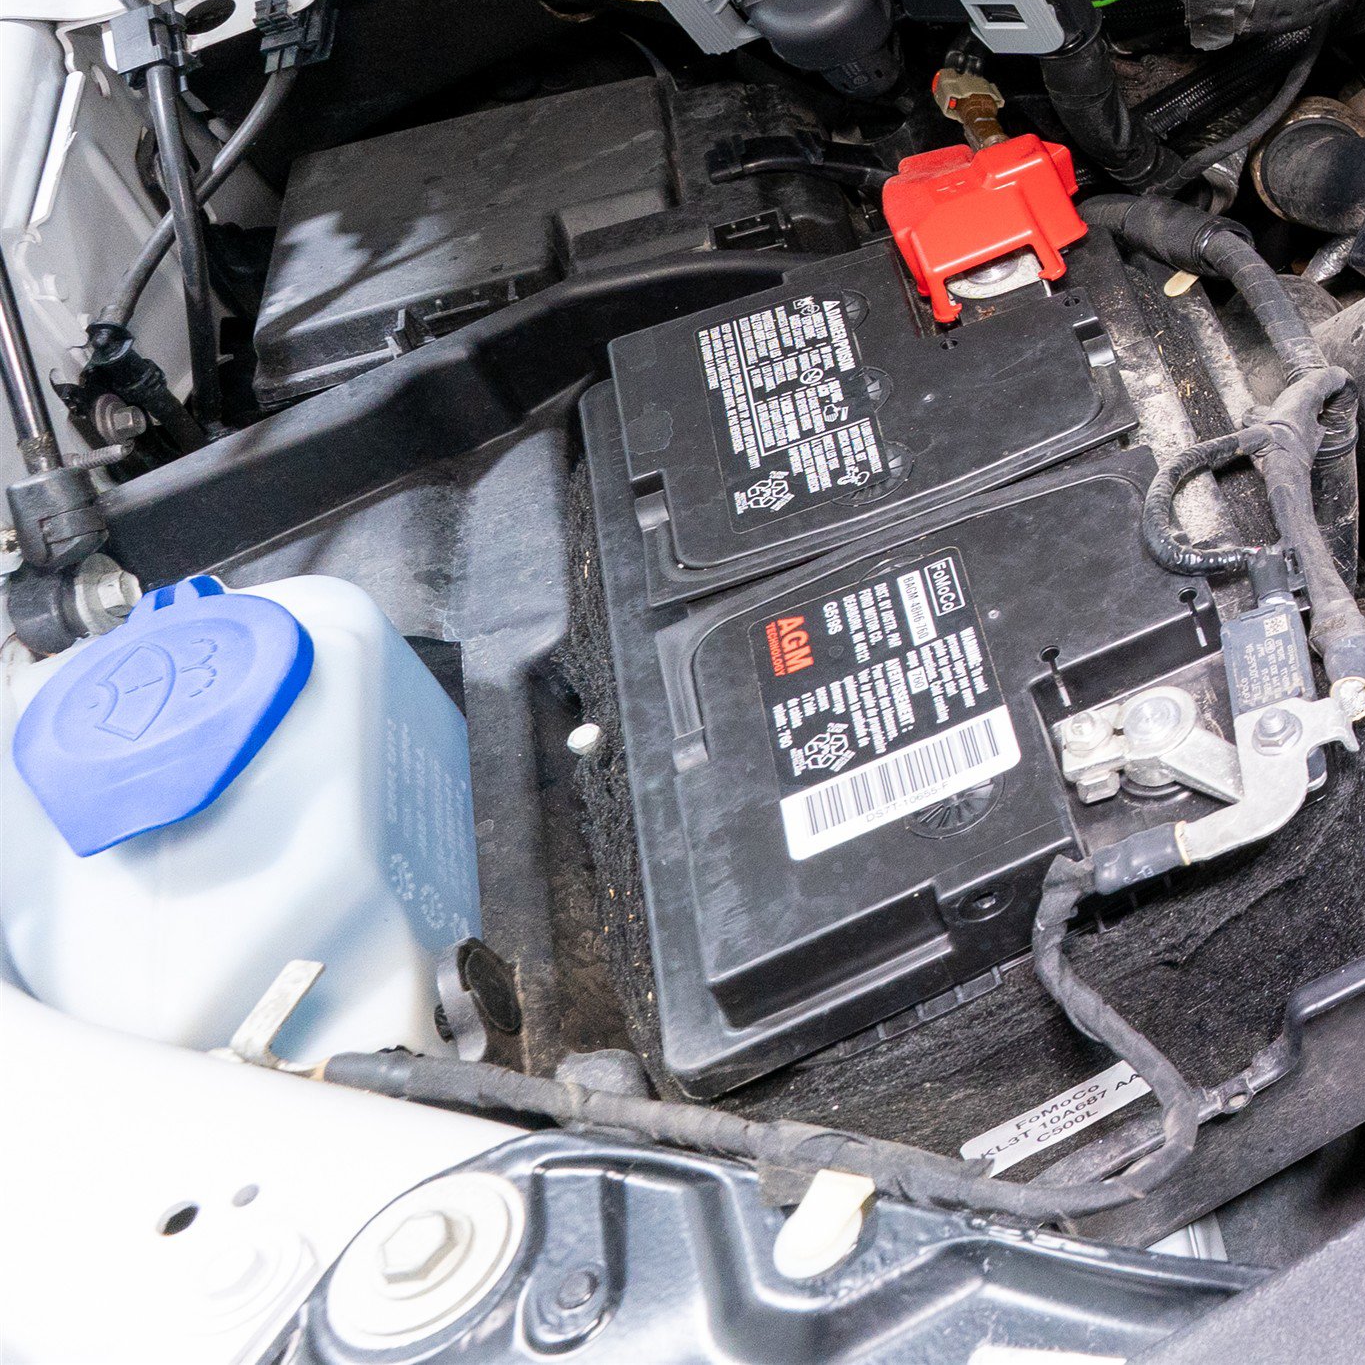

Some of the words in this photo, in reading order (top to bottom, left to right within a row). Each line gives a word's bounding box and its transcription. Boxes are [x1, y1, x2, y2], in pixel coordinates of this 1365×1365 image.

[824, 307, 854, 372] DANGER/POISON
[857, 587, 875, 608] FORD
[873, 581, 890, 601] DIST.
[928, 561, 959, 611] FoMoCo
[821, 600, 844, 635] G519S
[841, 593, 864, 634] DEARBORN,
[862, 606, 881, 633] MOTOR
[878, 598, 892, 611] BY
[880, 608, 898, 633] DISTR.
[900, 575, 932, 639] BAGM-48H6-760
[764, 621, 786, 678] TECHNOLOGY
[777, 615, 815, 675] AGM
[851, 631, 865, 643] MI
[853, 640, 871, 663] 48121
[868, 630, 884, 645] CO.
[885, 631, 902, 648] PAR
[957, 626, 985, 669] WARNING:
[882, 657, 917, 726] AVERTISSEMENT
[910, 670, 925, 689] 760
[777, 729, 793, 749] 760
[981, 1131, 1032, 1160] KL3T
[1039, 1090, 1107, 1130] 10A687
[1115, 1073, 1141, 1091] AA
[1016, 1084, 1100, 1131] FoMoCo
[1036, 1110, 1099, 1143] C500L
